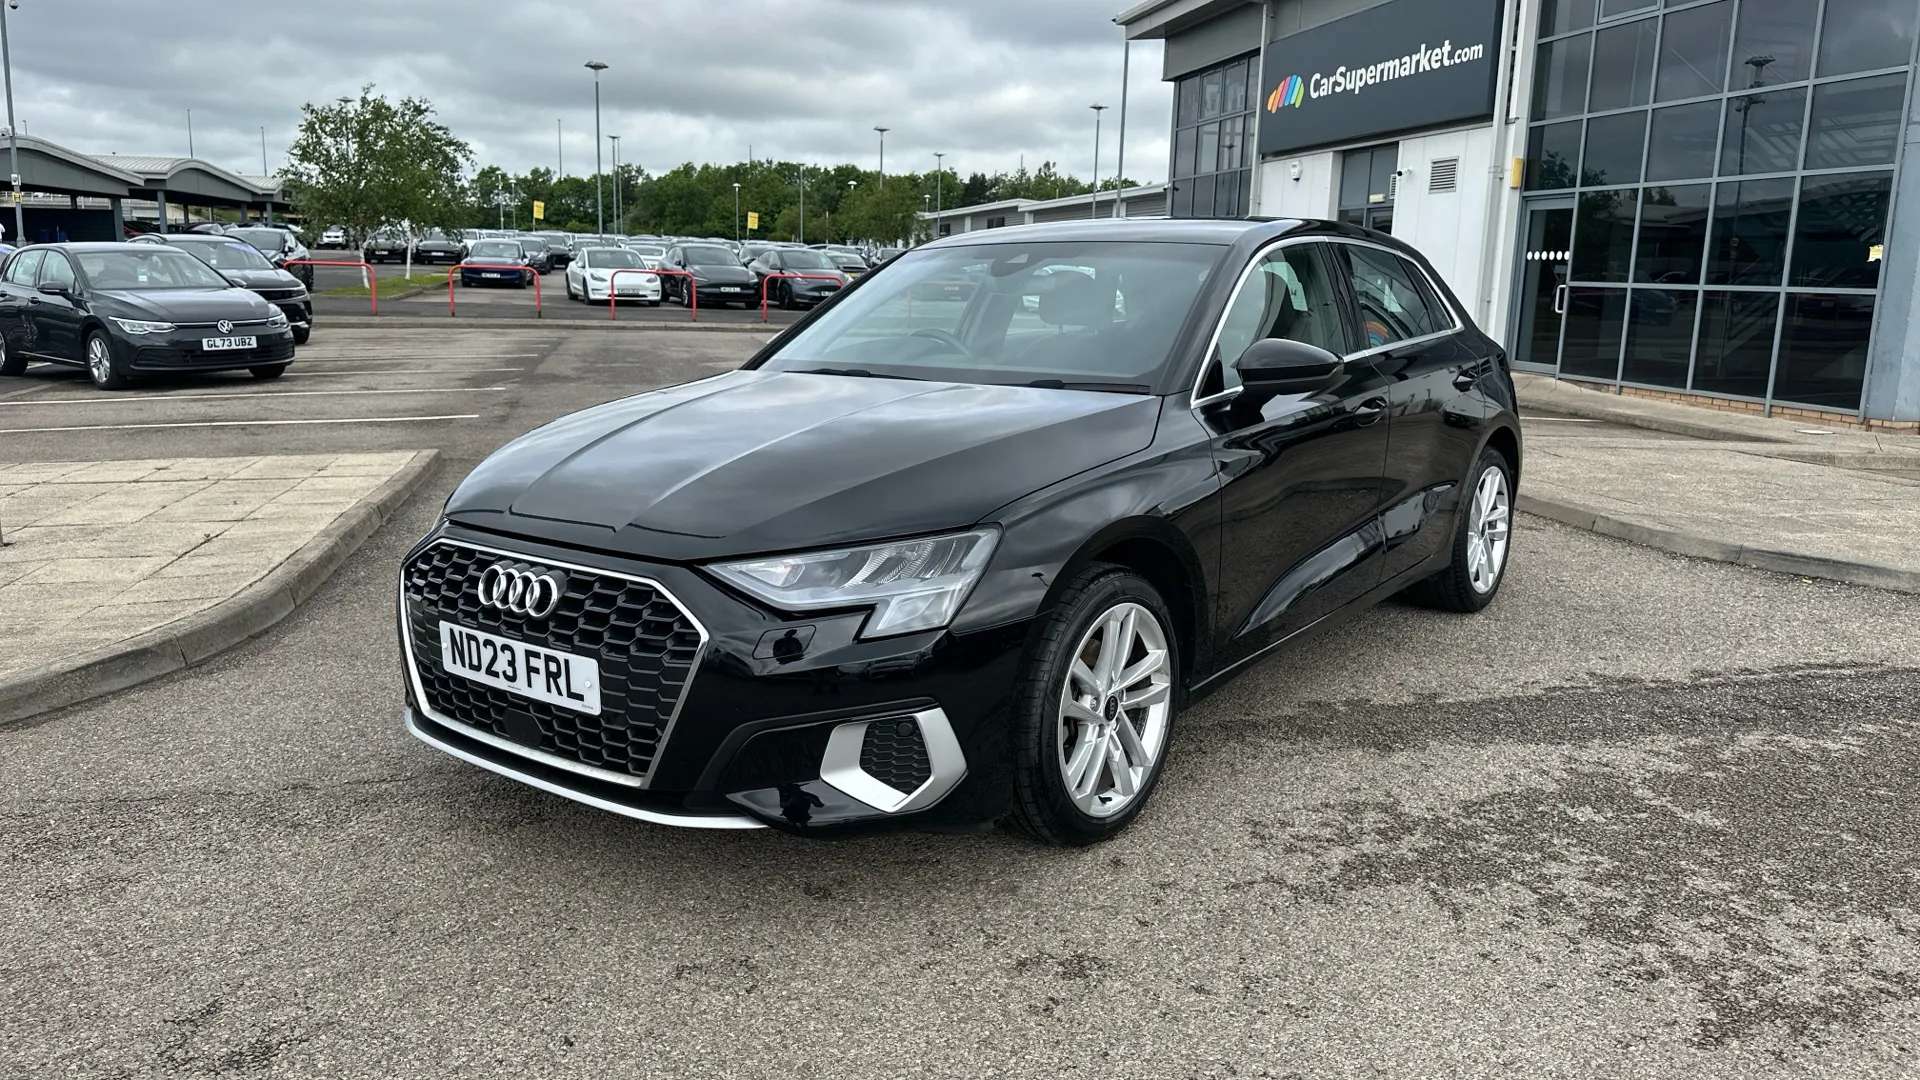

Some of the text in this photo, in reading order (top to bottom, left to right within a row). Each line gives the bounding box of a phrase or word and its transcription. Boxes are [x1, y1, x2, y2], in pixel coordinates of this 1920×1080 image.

[1309, 40, 1483, 99] CarSupermarket.com
[206, 337, 253, 348] GL73 UBZ
[449, 628, 585, 702] ND23 FRL
